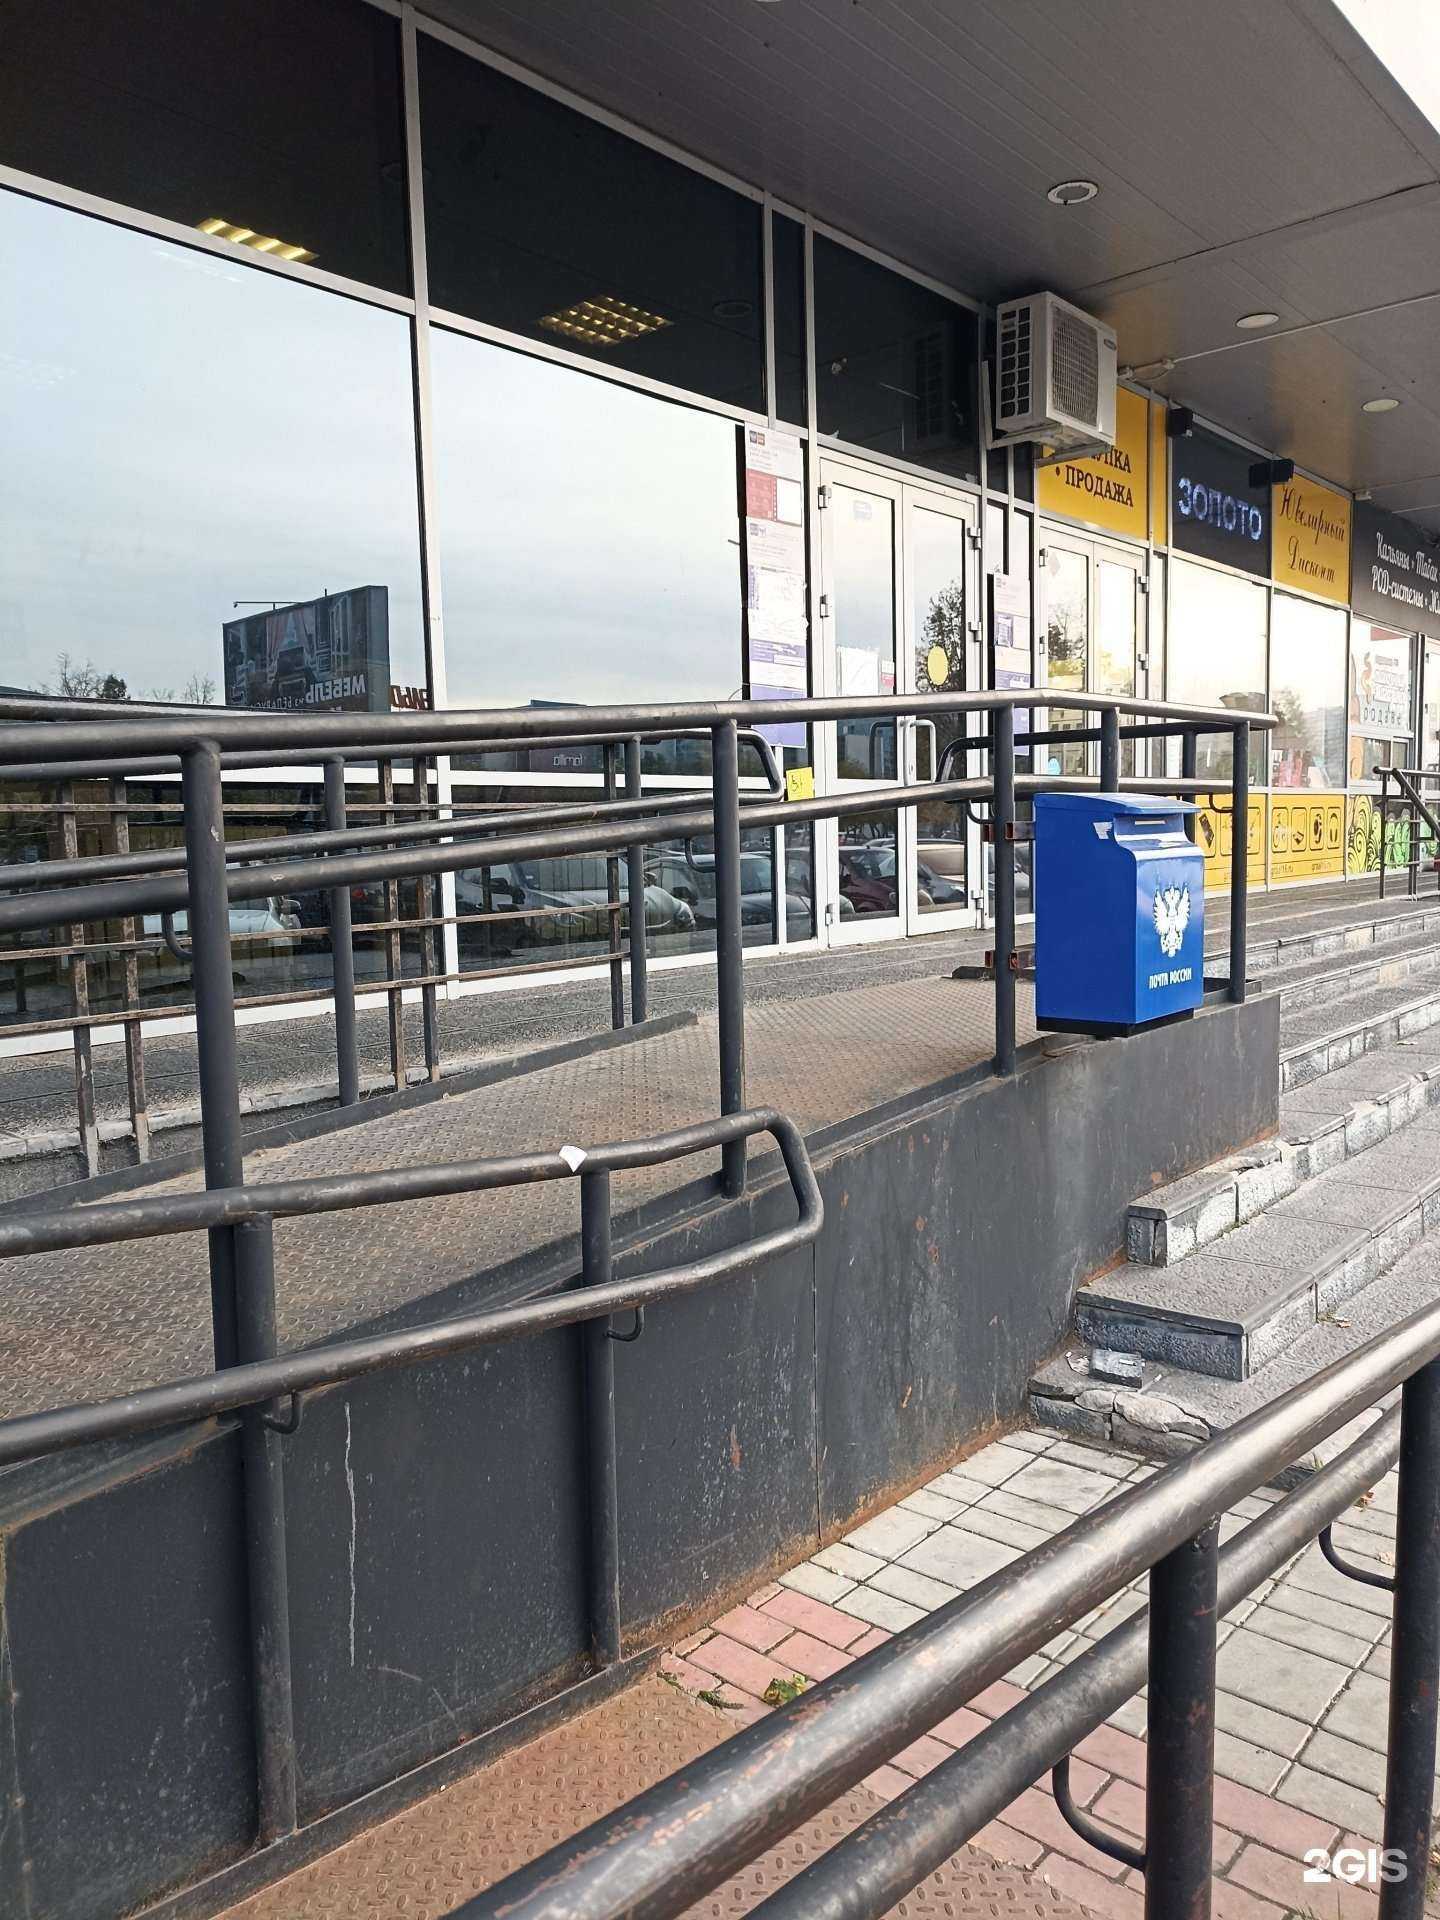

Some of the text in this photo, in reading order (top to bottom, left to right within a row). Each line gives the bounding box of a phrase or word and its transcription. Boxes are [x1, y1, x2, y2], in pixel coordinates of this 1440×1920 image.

[1065, 464, 1134, 508] ПРОДАЖА
[1280, 485, 1345, 544] Ювелирный
[1288, 535, 1335, 583] Дисконт
[1376, 531, 1438, 583] Кальяны Табак
[1371, 565, 1424, 609] POD-системы
[1149, 967, 1192, 990] ПОЧТА РОССИИ
